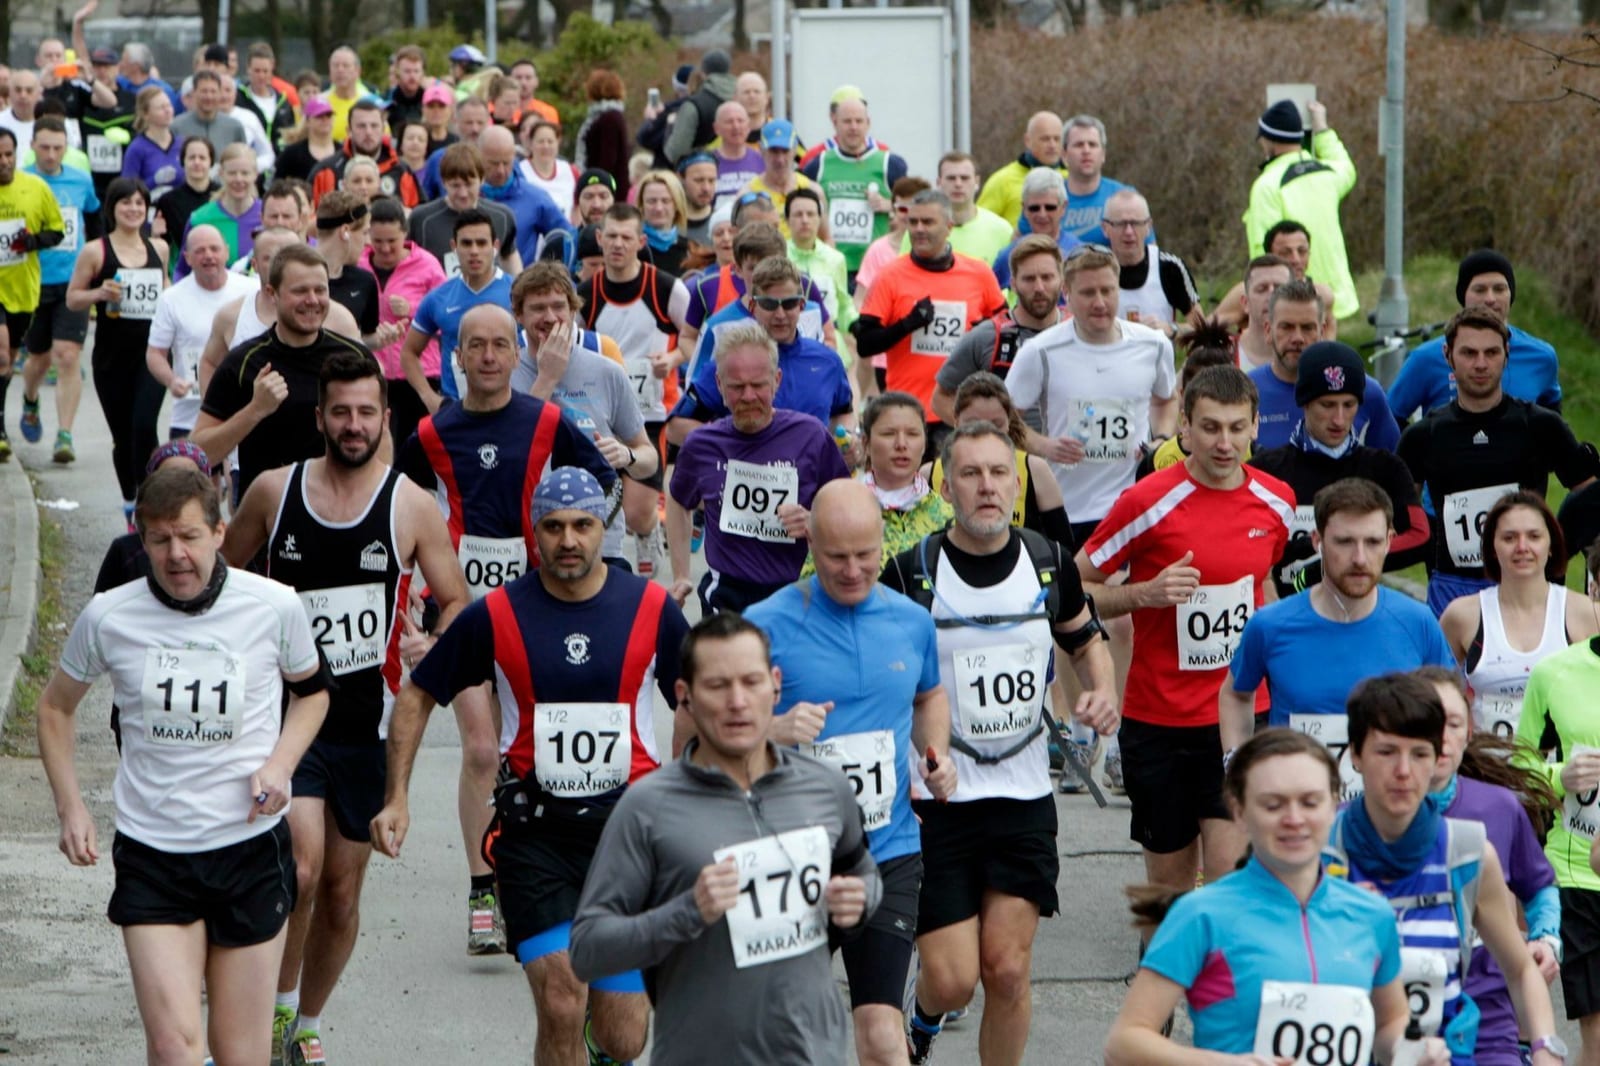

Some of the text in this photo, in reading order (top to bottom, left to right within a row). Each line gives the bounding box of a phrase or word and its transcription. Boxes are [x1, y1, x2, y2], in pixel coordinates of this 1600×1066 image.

[834, 211, 868, 228] 060
[122, 284, 158, 301] 135
[734, 468, 779, 483] MARATHON
[732, 483, 790, 516] 097
[1453, 496, 1468, 509] 1/2
[727, 520, 789, 538] MARATHON
[466, 543, 512, 555] MARATHON
[465, 559, 520, 588] 085
[309, 595, 329, 609] 1/2
[1187, 591, 1208, 605] 1/2
[311, 609, 379, 645] 210
[1187, 603, 1249, 642] 043
[157, 653, 181, 670] 1/2
[967, 654, 987, 670] 1/2
[156, 677, 228, 715] 111
[970, 670, 1036, 708] 108
[548, 710, 569, 724] 1/2
[970, 715, 1033, 735] MARATHON
[152, 725, 234, 742] MARATHON
[1302, 721, 1322, 736] 1/2
[548, 730, 621, 765] 107
[812, 743, 835, 758] 1/2
[545, 778, 622, 792] MARATHON
[739, 864, 822, 919] 176
[746, 924, 822, 957] MARATHON
[1279, 992, 1308, 1011] 1/2
[1272, 1019, 1362, 1066] 080
